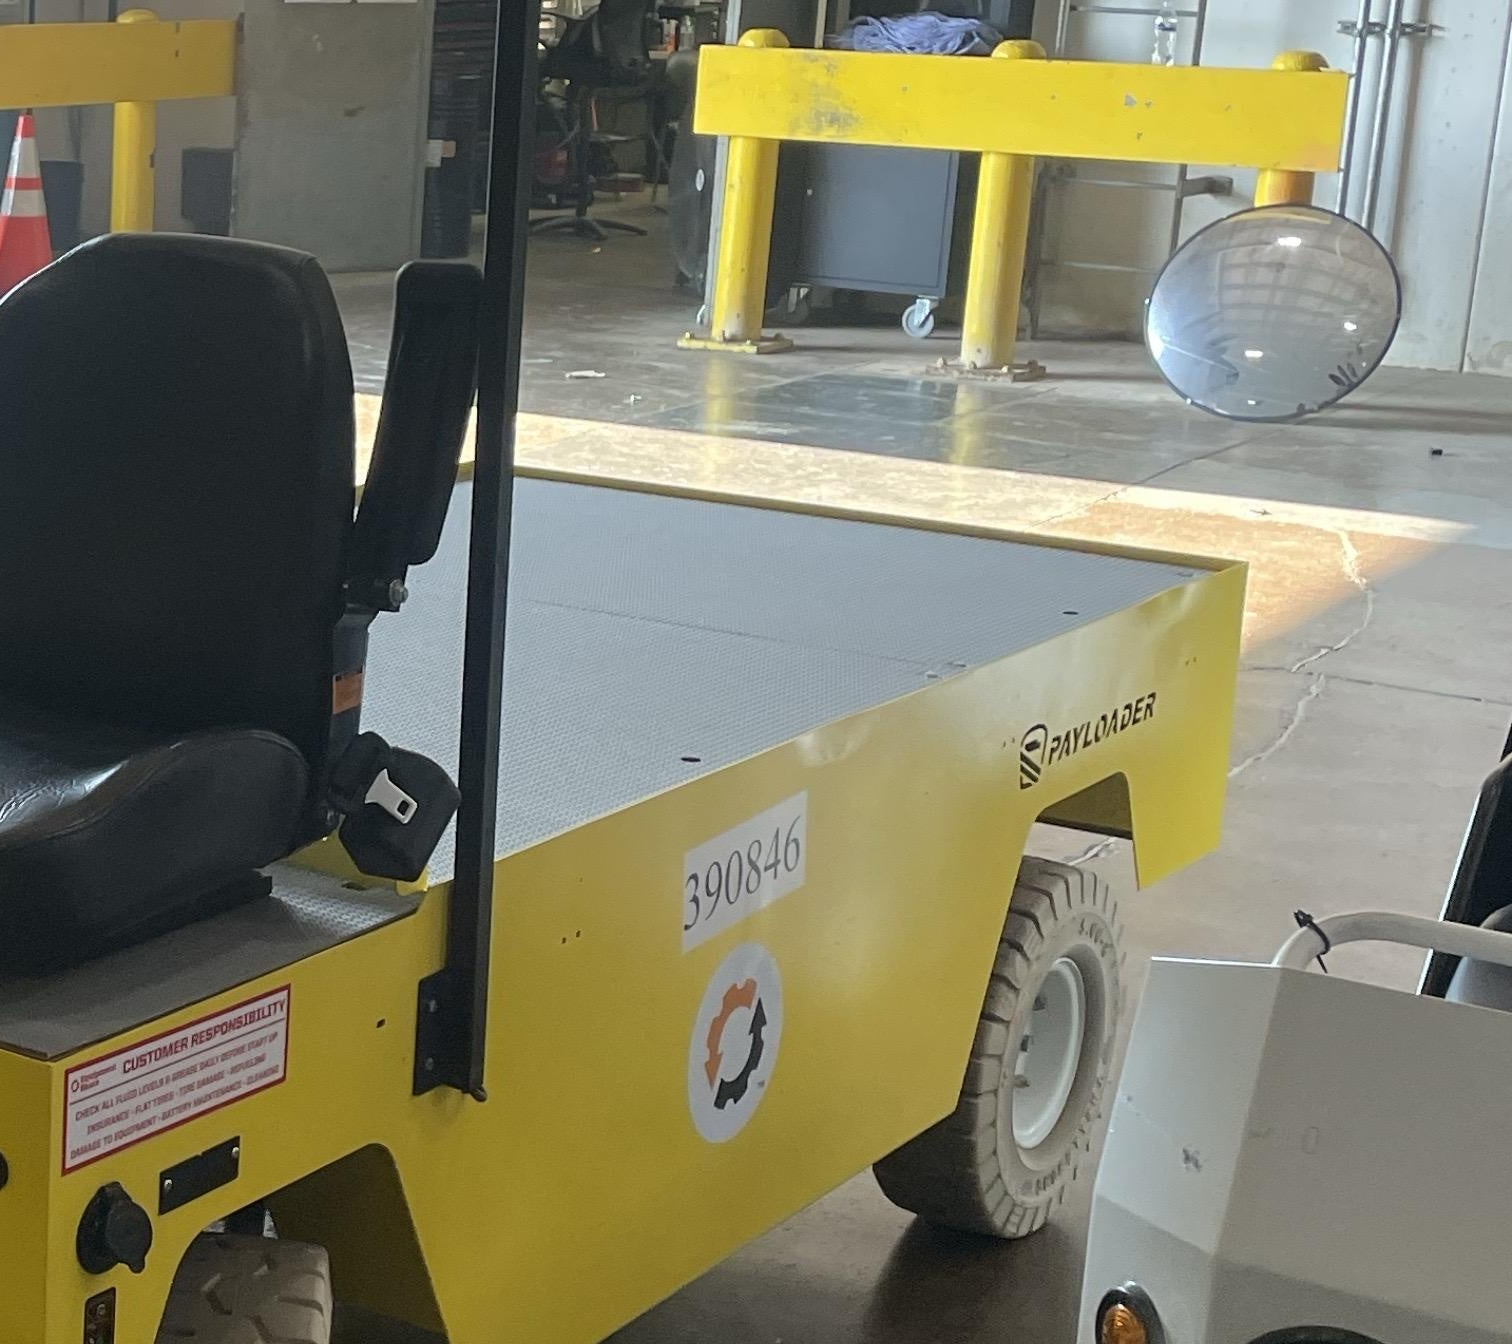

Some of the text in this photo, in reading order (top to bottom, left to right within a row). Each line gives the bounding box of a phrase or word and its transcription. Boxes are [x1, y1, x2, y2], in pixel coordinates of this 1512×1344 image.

[1048, 692, 1157, 766] PAYLOADER
[683, 816, 801, 931] 390846
[123, 999, 286, 1074] CUSTOMER RESPONSIBILITY
